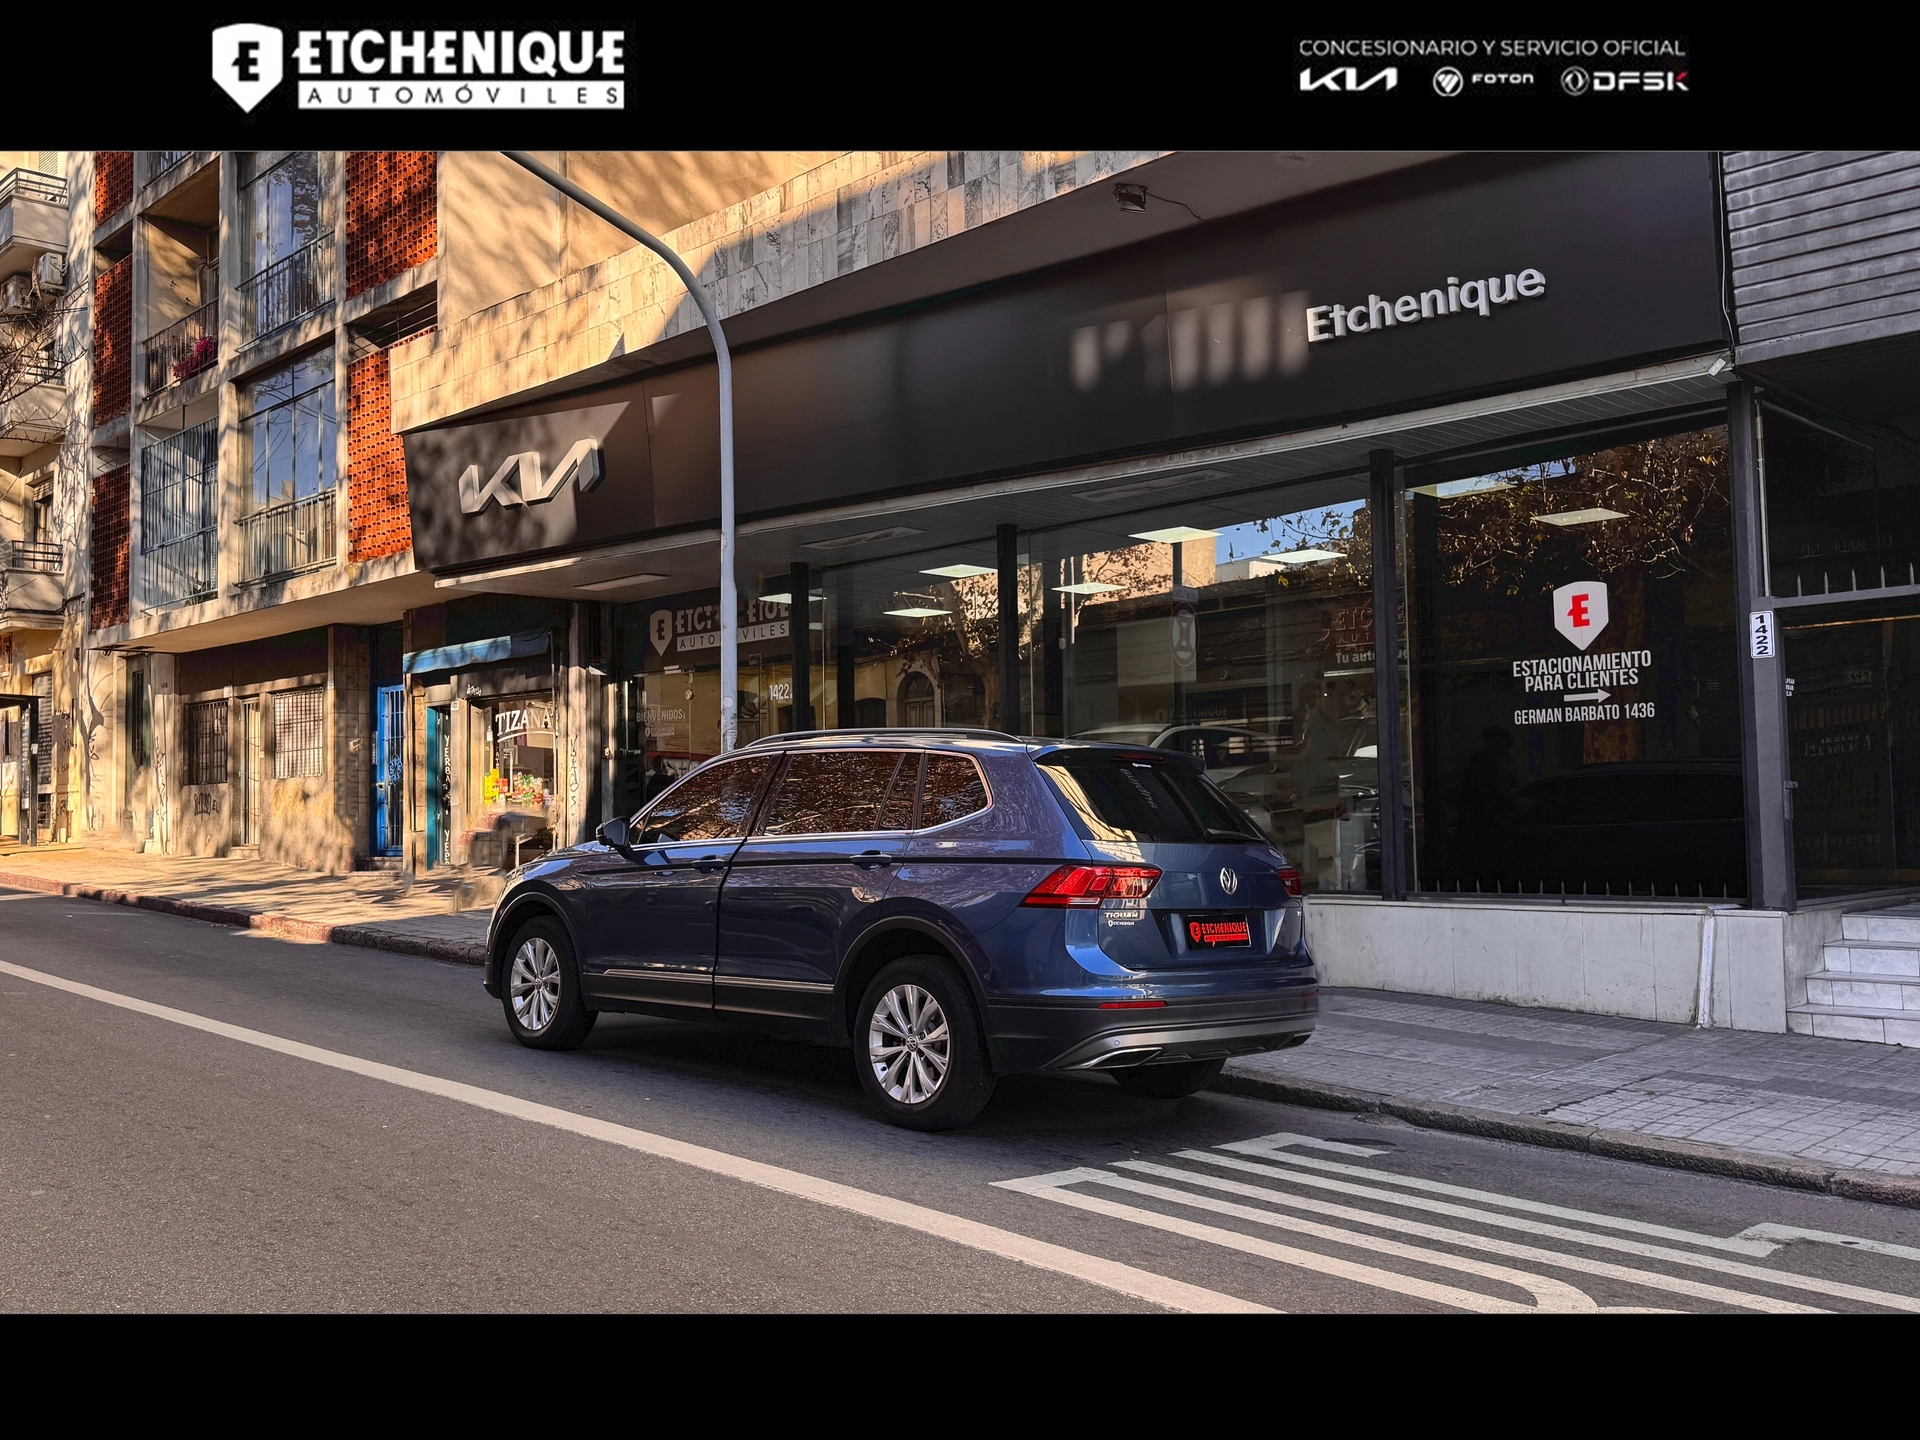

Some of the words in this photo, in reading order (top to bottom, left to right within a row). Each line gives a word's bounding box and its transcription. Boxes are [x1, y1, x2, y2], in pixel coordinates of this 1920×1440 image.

[1306, 268, 1546, 342] Etchenique
[1755, 614, 1769, 655] 1422
[1335, 652, 1350, 664] Tu
[1352, 650, 1375, 662] aut
[1512, 650, 1652, 677] ESTACIONAMIENTO
[1524, 674, 1564, 692] PARA
[1567, 668, 1639, 690] CLIENTES
[1514, 707, 1562, 725] GERMAN
[1565, 704, 1620, 722] BARBATO
[1624, 702, 1656, 719] 1436
[1201, 921, 1247, 935] ETCHENIQUE
